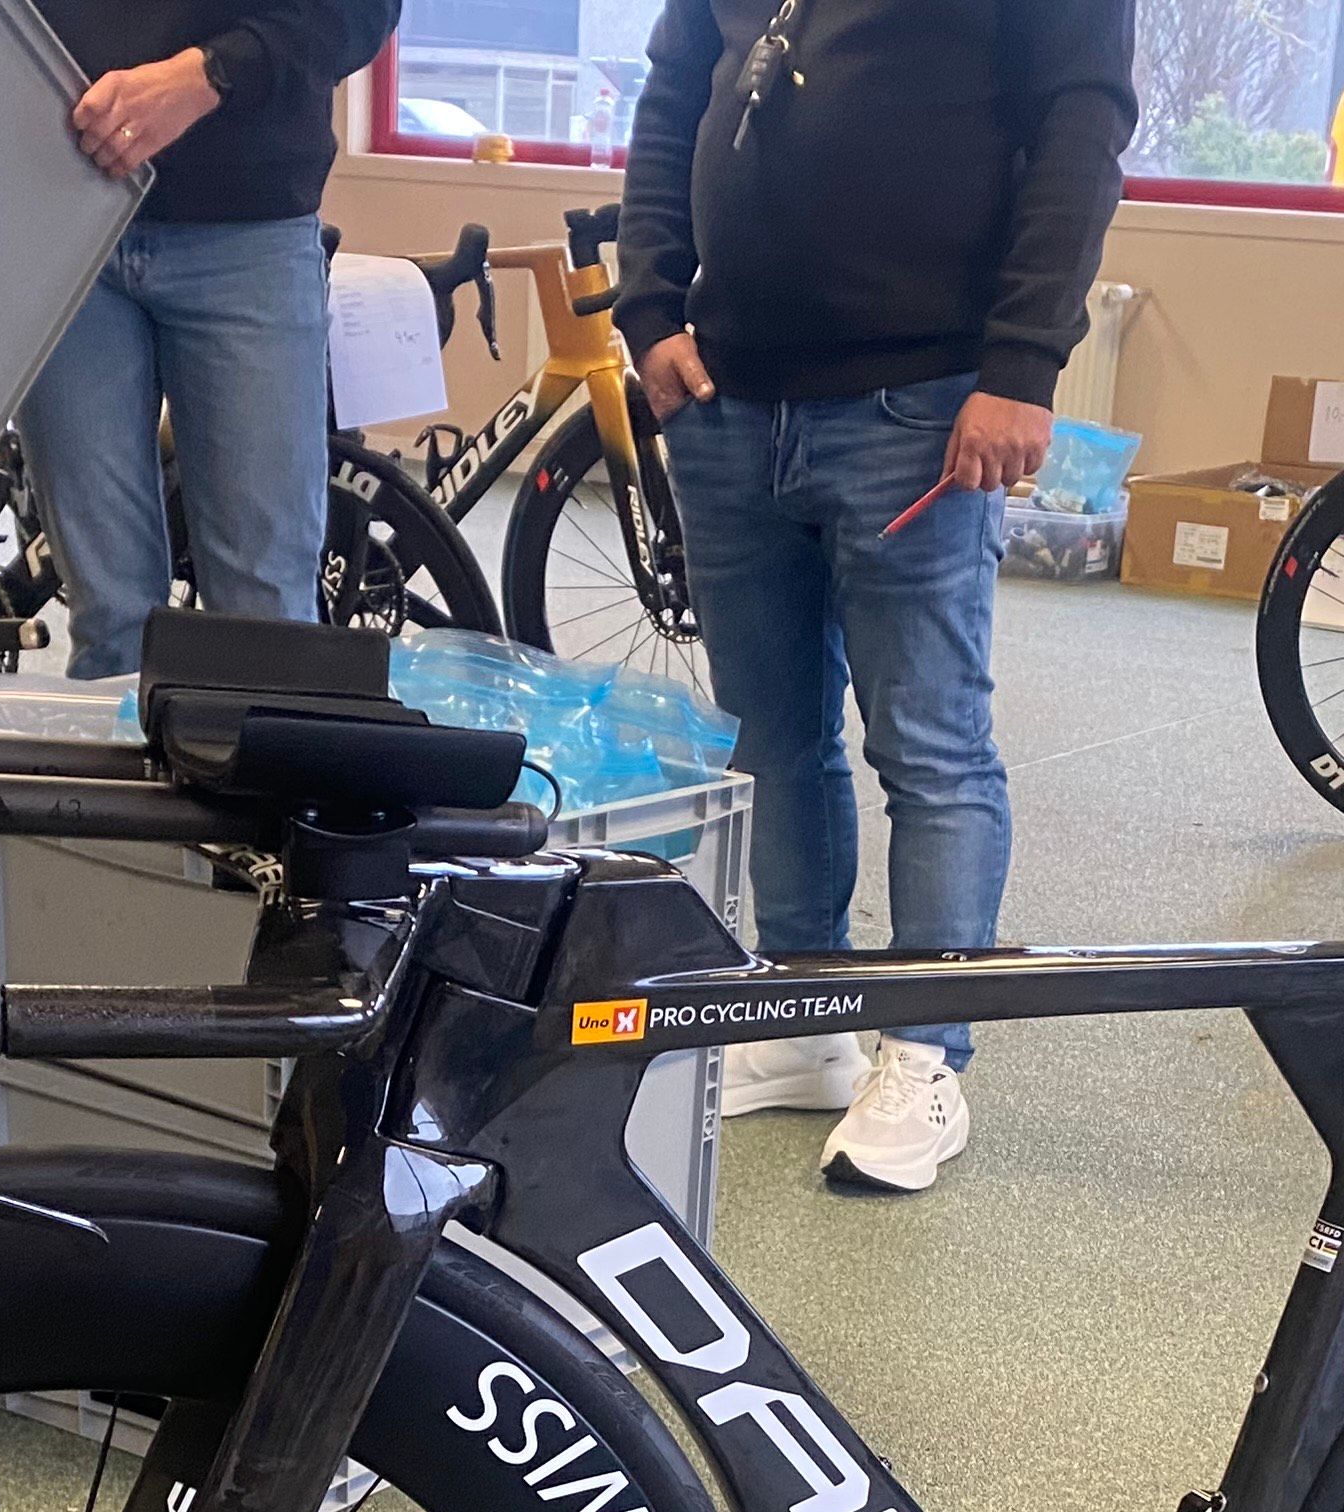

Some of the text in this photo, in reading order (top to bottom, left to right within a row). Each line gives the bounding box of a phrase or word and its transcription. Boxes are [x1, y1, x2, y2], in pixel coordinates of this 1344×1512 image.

[330, 460, 381, 503] DT
[627, 484, 654, 577] RIDLEY
[578, 1016, 609, 1030] Uno
[649, 1006, 696, 1028] PRO
[700, 999, 796, 1024] CYCLING
[801, 994, 863, 1017] TEAM
